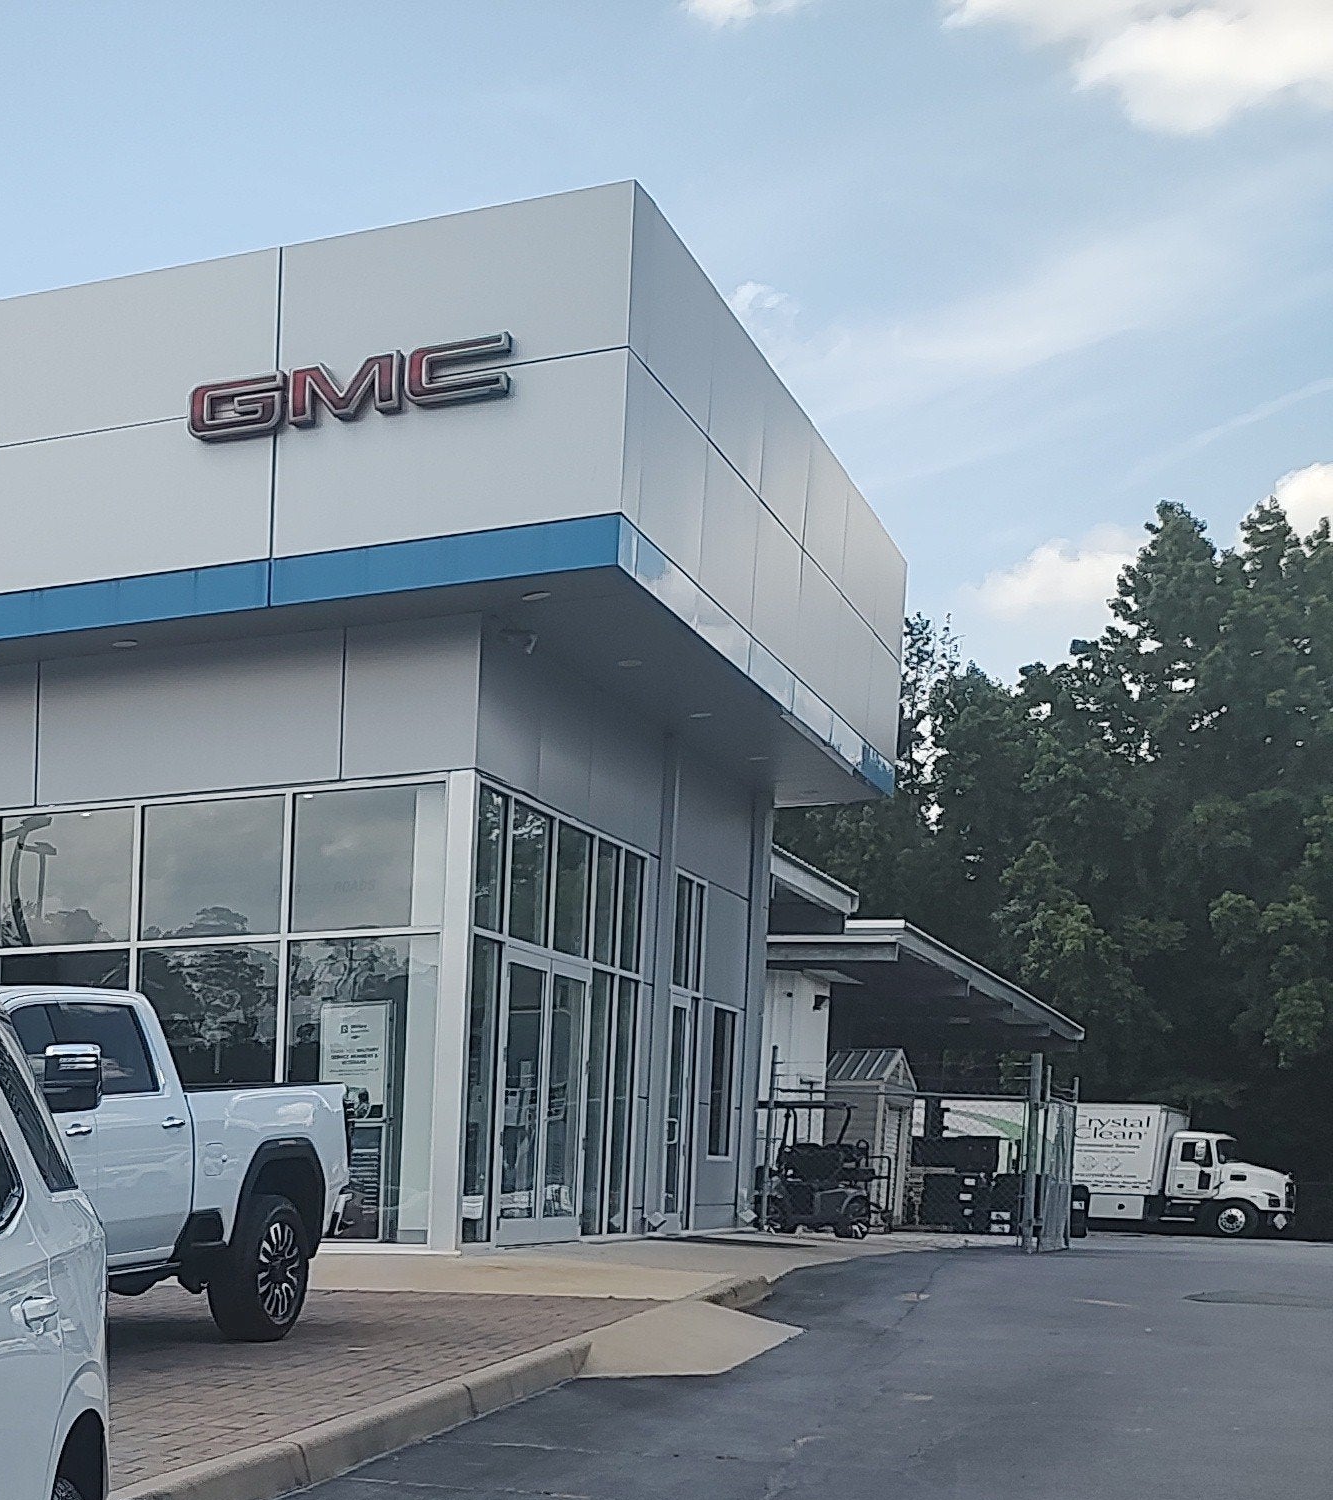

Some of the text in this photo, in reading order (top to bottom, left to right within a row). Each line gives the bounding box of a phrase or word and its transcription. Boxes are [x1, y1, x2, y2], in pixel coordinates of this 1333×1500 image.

[187, 331, 513, 442] GMC
[1077, 1115, 1151, 1130] Crystal
[1075, 1126, 1144, 1141] Clean
